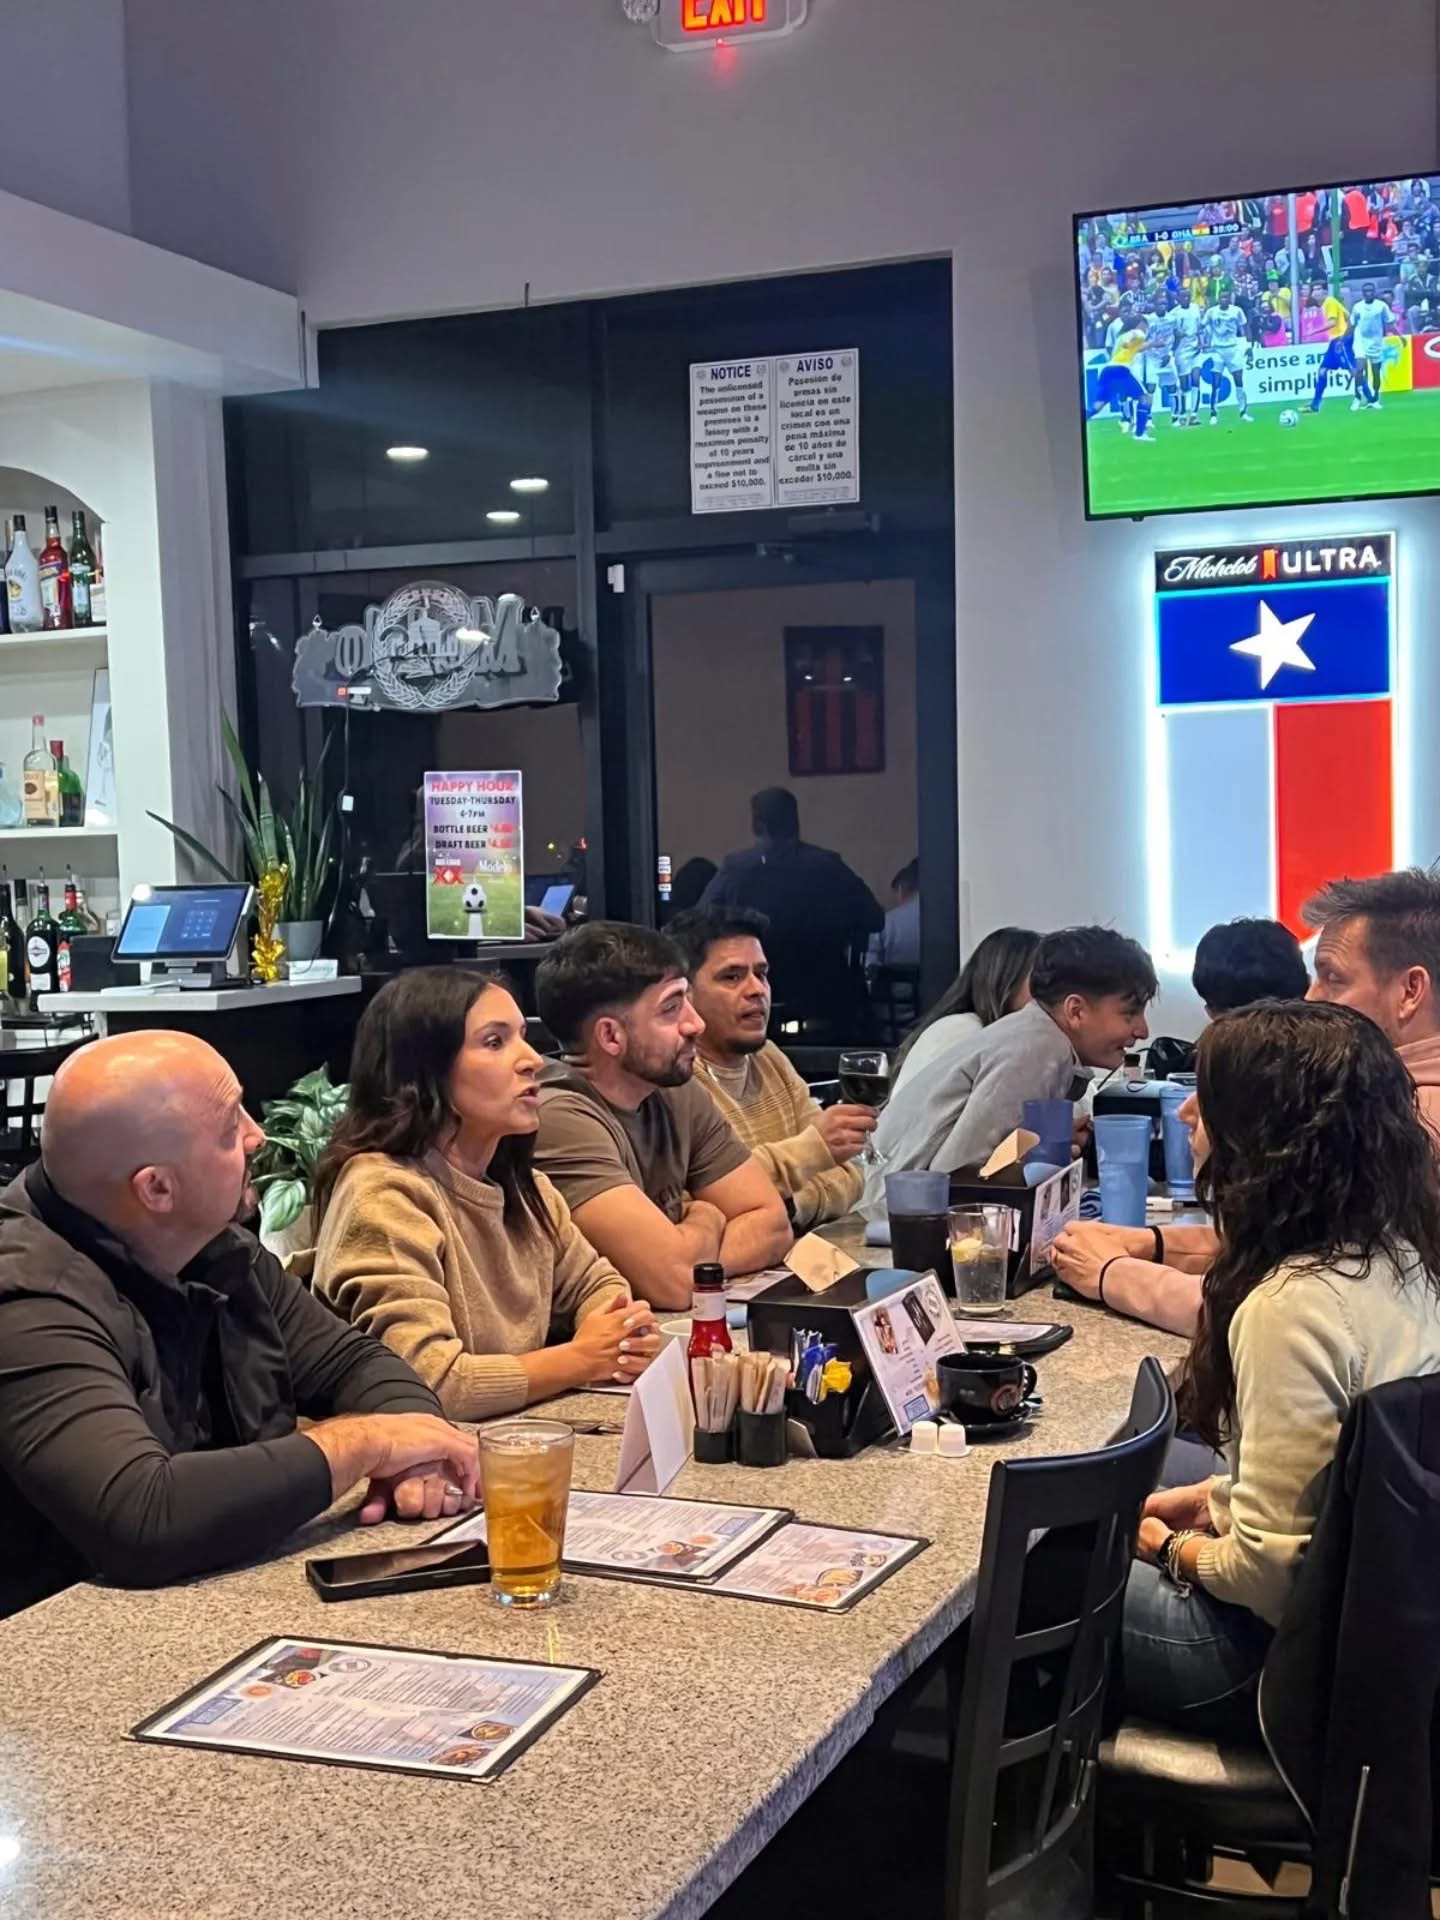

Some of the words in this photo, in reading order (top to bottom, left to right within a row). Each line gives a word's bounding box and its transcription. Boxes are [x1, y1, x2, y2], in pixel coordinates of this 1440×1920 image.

[797, 357, 833, 372] AVISO
[711, 365, 751, 380] NOTICE
[831, 373, 842, 381] de
[1258, 370, 1353, 395] simpliity
[700, 386, 715, 394] The
[793, 388, 821, 397] armas
[824, 386, 837, 394] sin
[748, 392, 756, 400] of
[832, 395, 851, 404] este
[791, 408, 812, 418] local
[781, 421, 811, 430] crimen
[814, 420, 831, 428] con
[834, 418, 850, 426] una
[738, 436, 768, 445] penalty
[786, 432, 807, 441] pena
[798, 441, 808, 450] 10
[835, 439, 847, 447] de
[709, 449, 717, 457] of
[721, 448, 729, 456] 10
[732, 448, 754, 457] years
[827, 451, 843, 459] una
[753, 456, 769, 464] and
[823, 462, 836, 470] sin
[1164, 555, 1258, 582] Michelob
[1282, 545, 1378, 573] ULTRA
[431, 781, 473, 793] HAPPY
[477, 779, 513, 791] HOUR
[429, 796, 516, 805] TUESDAY-THURSDAY
[433, 824, 464, 833] BOTTLE
[466, 824, 488, 833] BEER
[435, 840, 465, 849] DRAFT
[465, 840, 486, 849] BEER
[479, 859, 512, 872] Modelo
